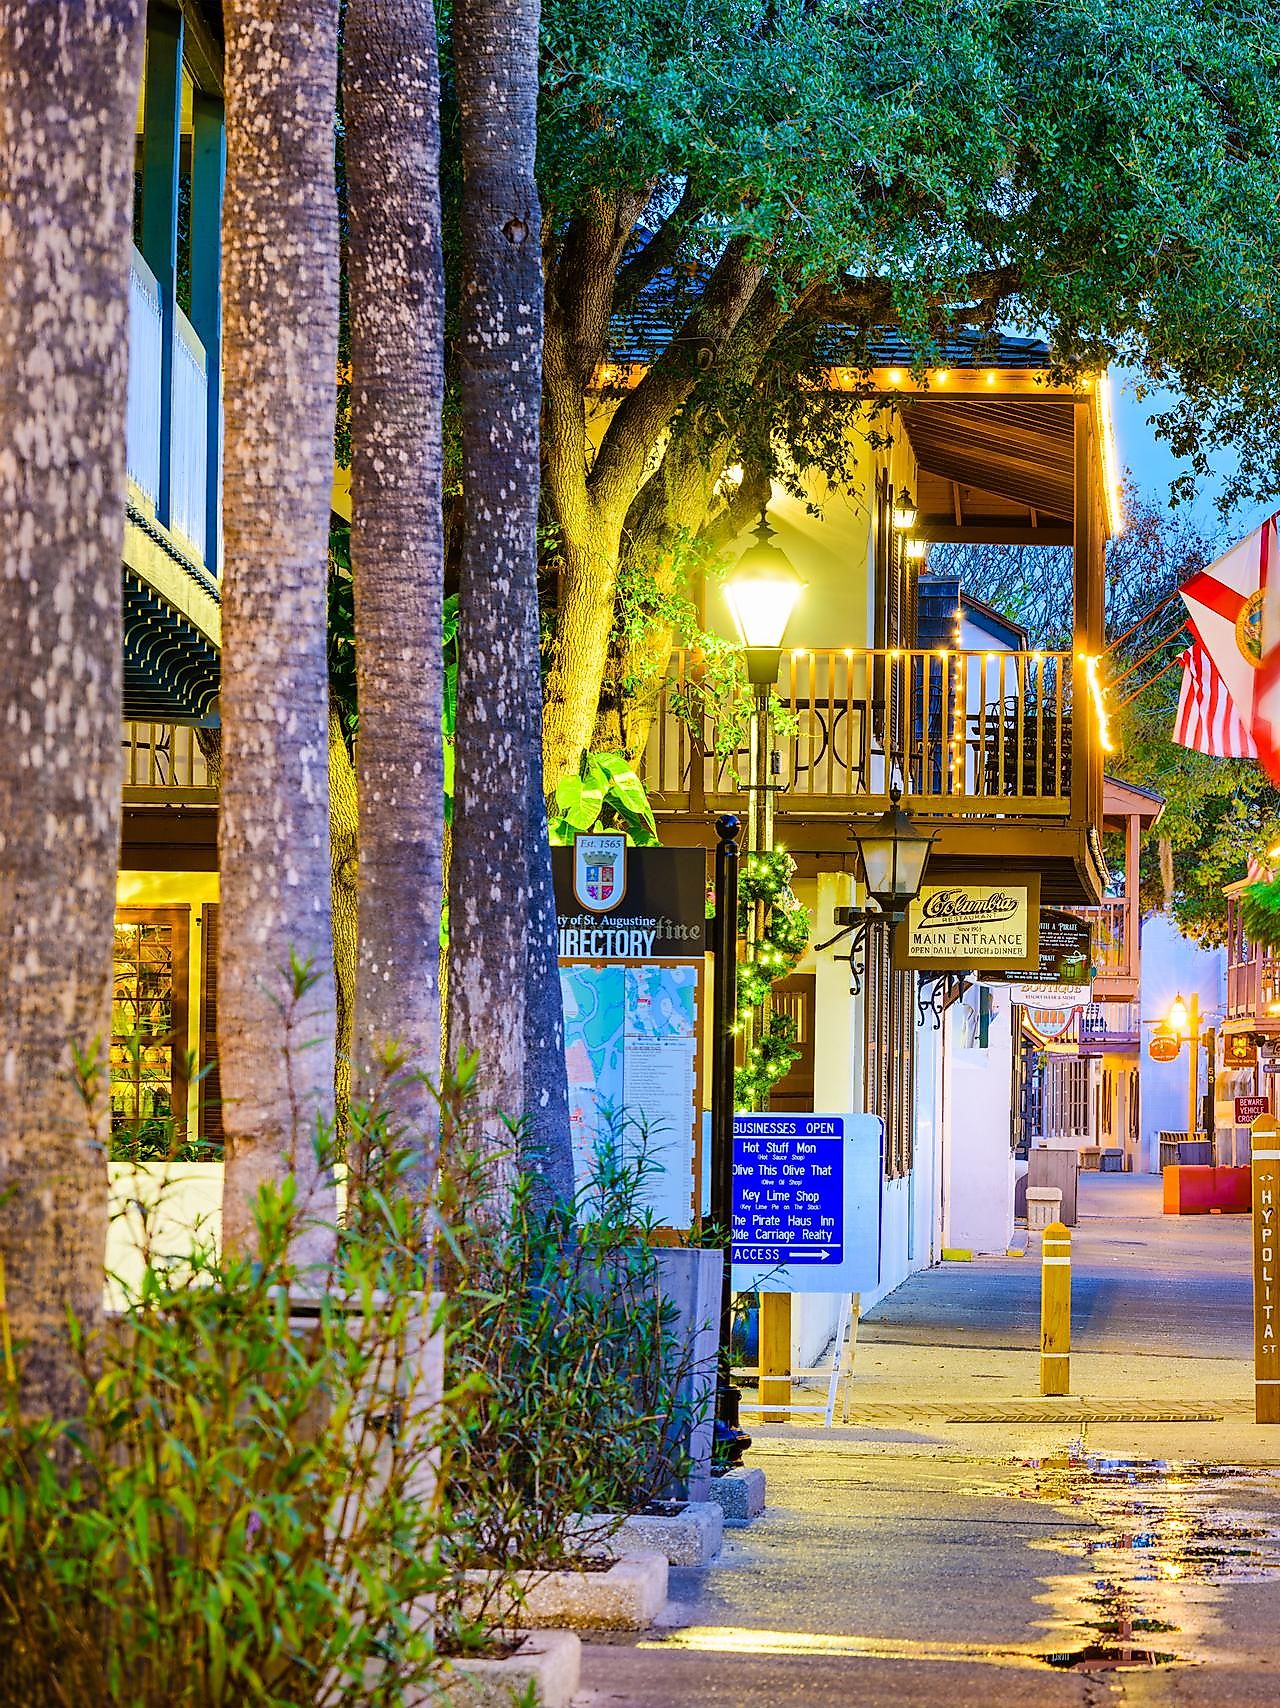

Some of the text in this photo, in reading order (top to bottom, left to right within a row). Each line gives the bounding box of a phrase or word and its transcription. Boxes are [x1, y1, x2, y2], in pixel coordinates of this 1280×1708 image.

[580, 839, 621, 849] Est. 1565
[922, 889, 1020, 918] Columbia
[557, 914, 656, 928] ty of St. Augustine
[942, 913, 997, 923] RESTAURANT
[559, 929, 656, 957] IRECTORY
[913, 934, 1023, 945] MAIN ENTRANCE
[910, 947, 930, 955] OPEN
[963, 947, 989, 955] LUNCH
[994, 947, 1023, 955] DINNER
[1208, 1067, 1214, 1083] 53
[733, 1122, 834, 1134] BUSINESSES OPEN
[743, 1142, 816, 1153] Hot Stuff Mon
[732, 1164, 832, 1175] Olive This Olive That
[742, 1189, 819, 1203] Key Lime Shop
[732, 1215, 834, 1226] The Pirate Haus Inn
[731, 1229, 832, 1243] Olde Carriage Realty
[734, 1249, 779, 1260] ACCESS
[1261, 1190, 1274, 1339] HYPOLITA
[1263, 1345, 1276, 1354] ST
